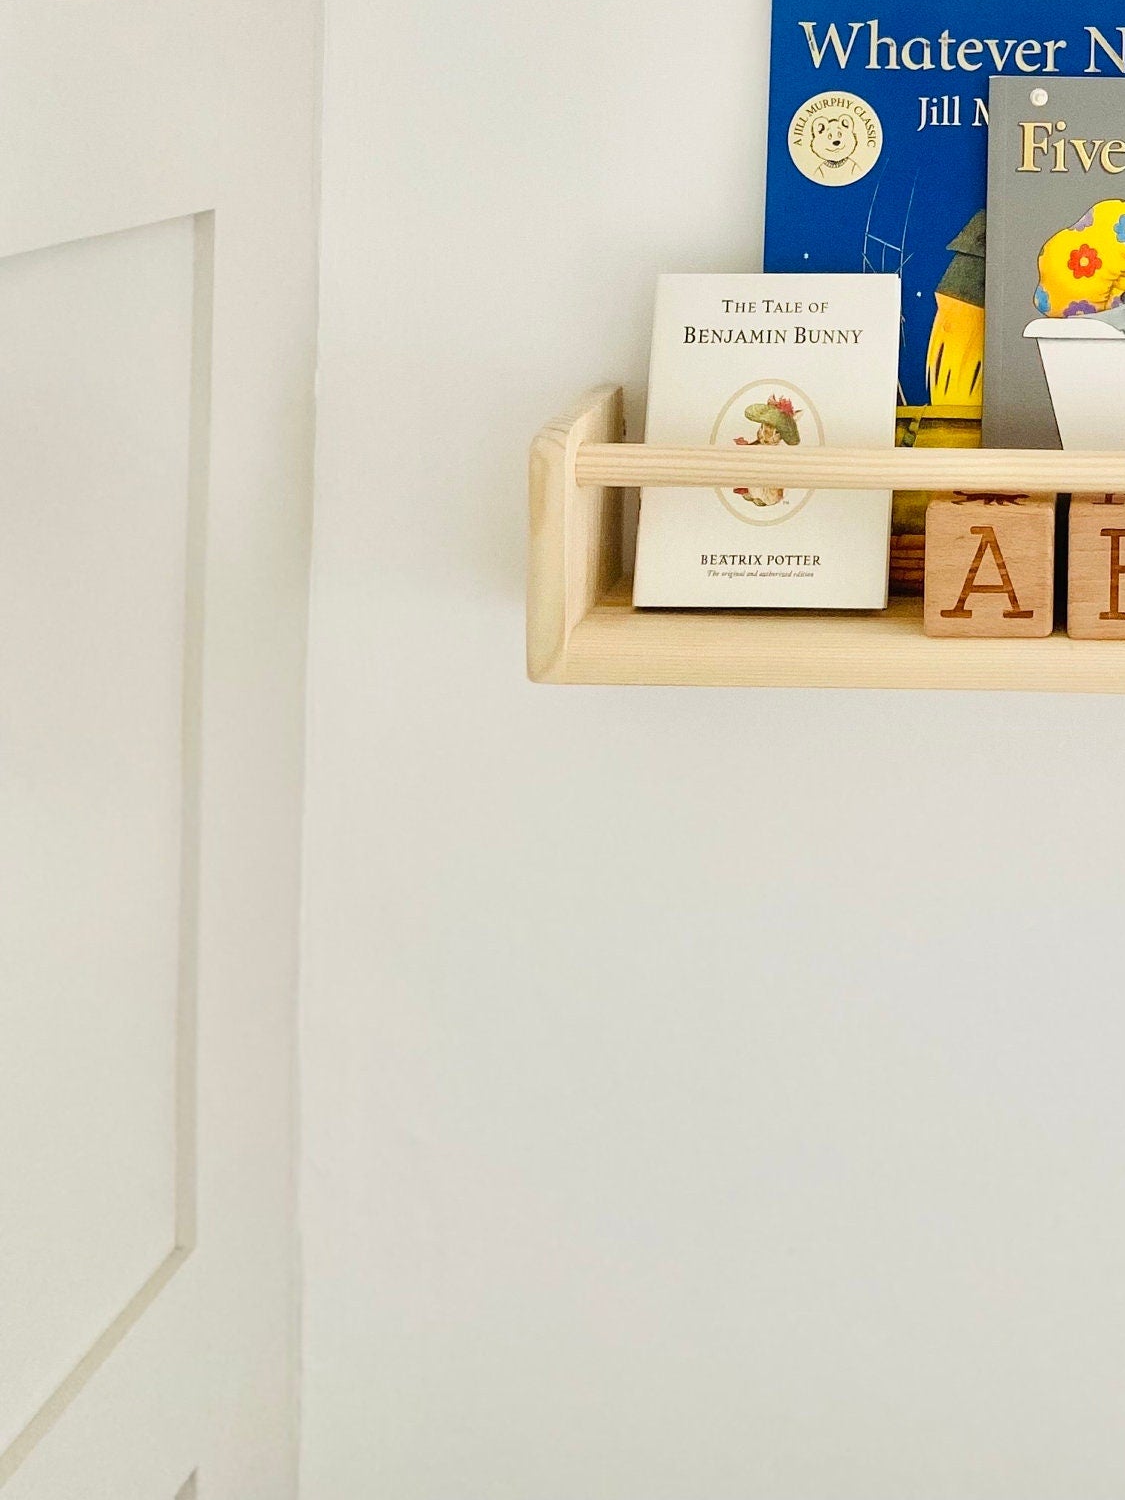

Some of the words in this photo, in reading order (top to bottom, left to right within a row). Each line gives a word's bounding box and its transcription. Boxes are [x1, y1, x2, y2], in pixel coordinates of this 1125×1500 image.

[798, 19, 1067, 73] Whatever
[806, 97, 853, 116] MURPHY
[917, 96, 961, 131] Jill
[794, 117, 808, 136] JILL
[854, 106, 876, 148] CLASSIC
[793, 138, 803, 146] A
[701, 554, 763, 566] BEATRIX
[766, 554, 821, 566] POTTER
[721, 570, 745, 579] original
[793, 570, 814, 578] edition
[940, 526, 1033, 618] A
